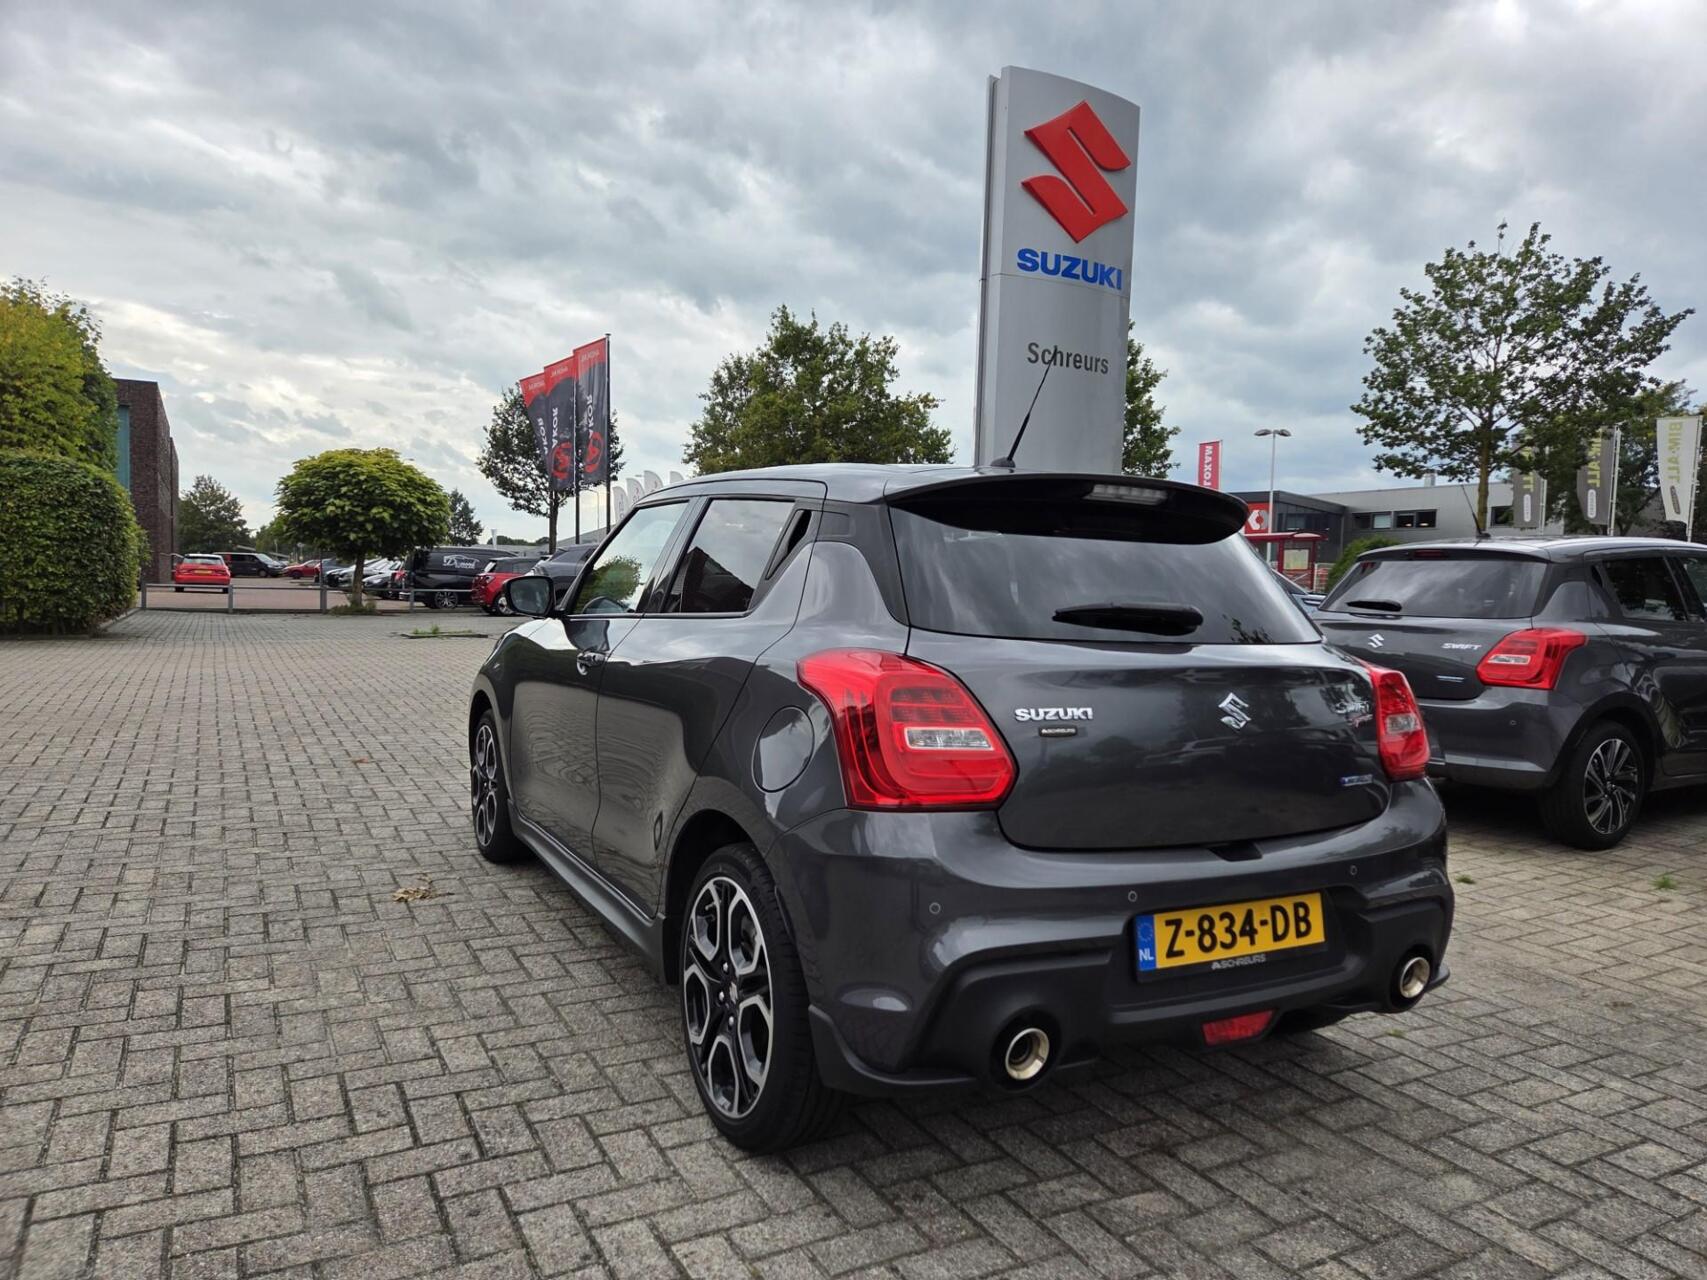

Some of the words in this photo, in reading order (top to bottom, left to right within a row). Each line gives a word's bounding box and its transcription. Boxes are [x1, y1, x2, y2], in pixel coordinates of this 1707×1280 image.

[1017, 248, 1122, 290] SUZUKI
[1027, 342, 1109, 374] Schreurs
[1441, 642, 1482, 650] SWIFT
[1015, 707, 1094, 721] SUZUKI
[1164, 901, 1312, 959] Z-834-DB
[1138, 948, 1154, 961] NL
